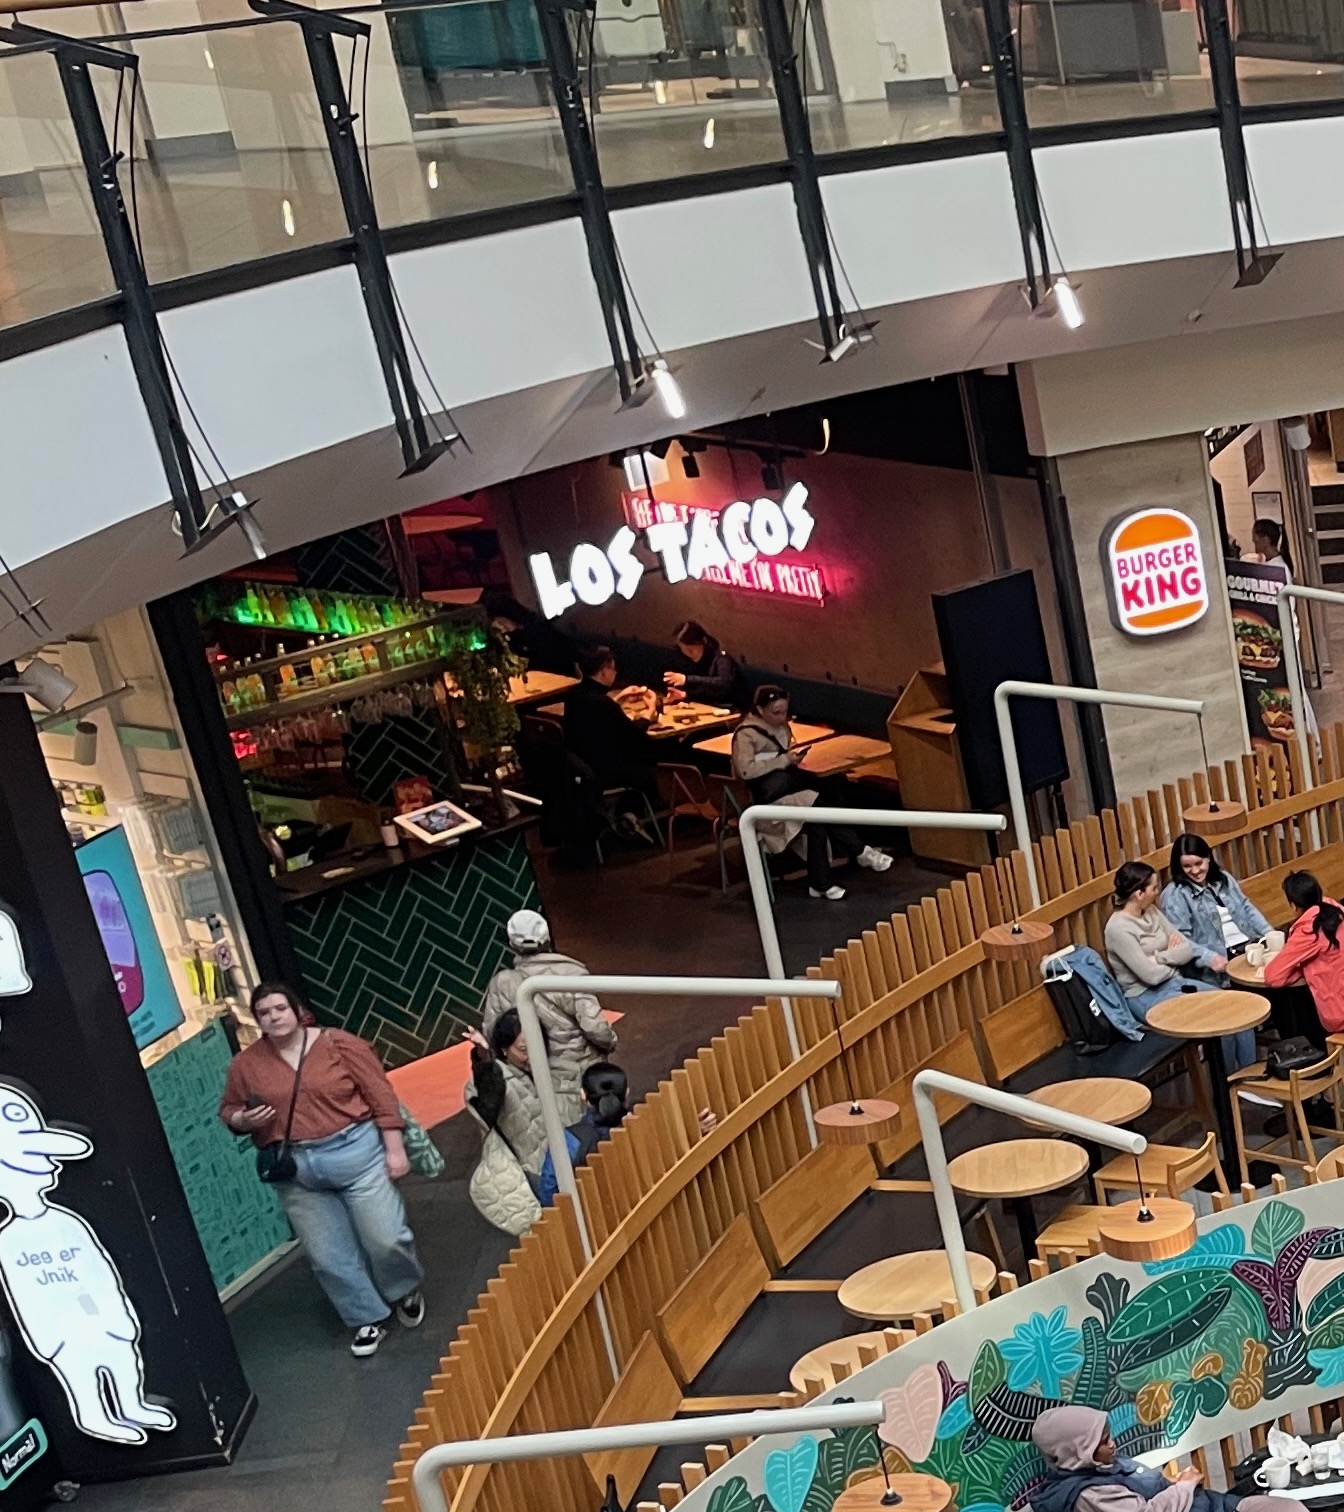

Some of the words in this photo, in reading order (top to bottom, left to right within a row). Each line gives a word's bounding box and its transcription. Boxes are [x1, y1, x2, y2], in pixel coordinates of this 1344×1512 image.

[529, 525, 645, 621] LOS
[646, 481, 815, 586] TACOS
[1117, 542, 1198, 579] BURGER
[1121, 565, 1201, 612] KING
[59, 1246, 81, 1262] er
[1, 1433, 36, 1474] Normal
